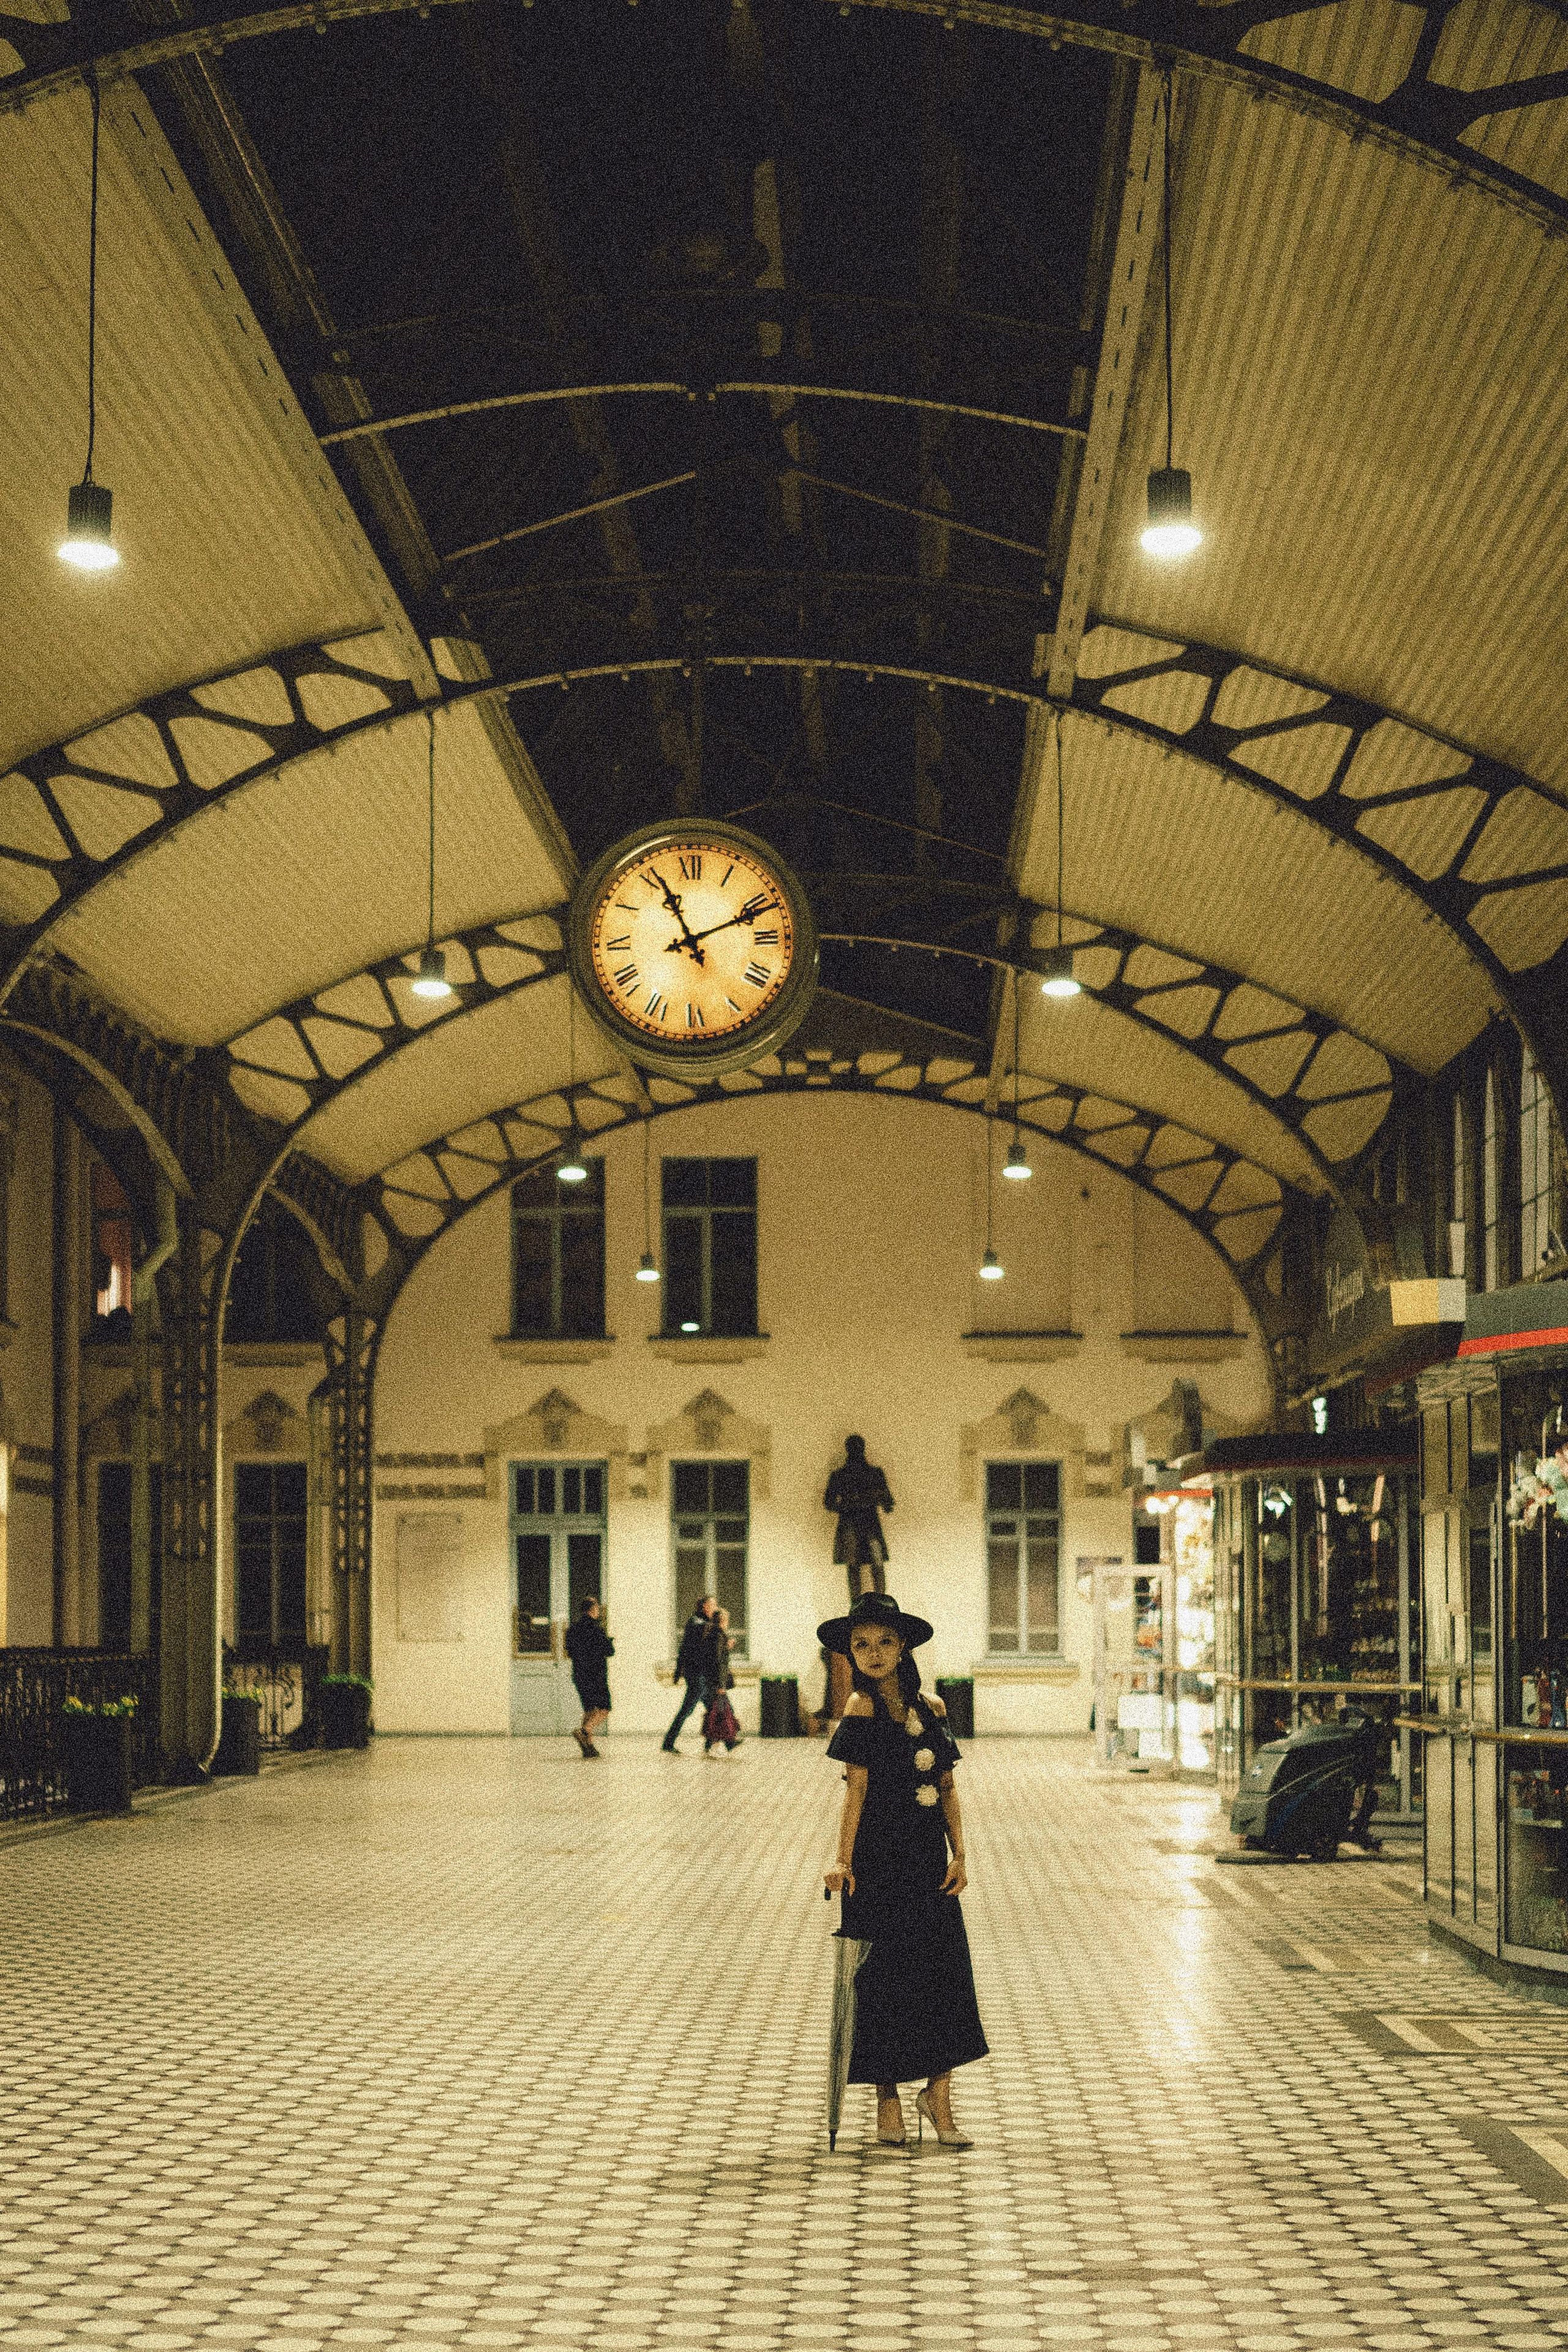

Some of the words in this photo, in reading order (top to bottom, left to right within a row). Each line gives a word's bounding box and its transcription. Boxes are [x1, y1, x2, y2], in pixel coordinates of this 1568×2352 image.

[679, 855, 702, 880] XII
[721, 865, 734, 888] I
[743, 892, 768, 909] II
[754, 930, 778, 945] III
[742, 962, 772, 989] IIII
